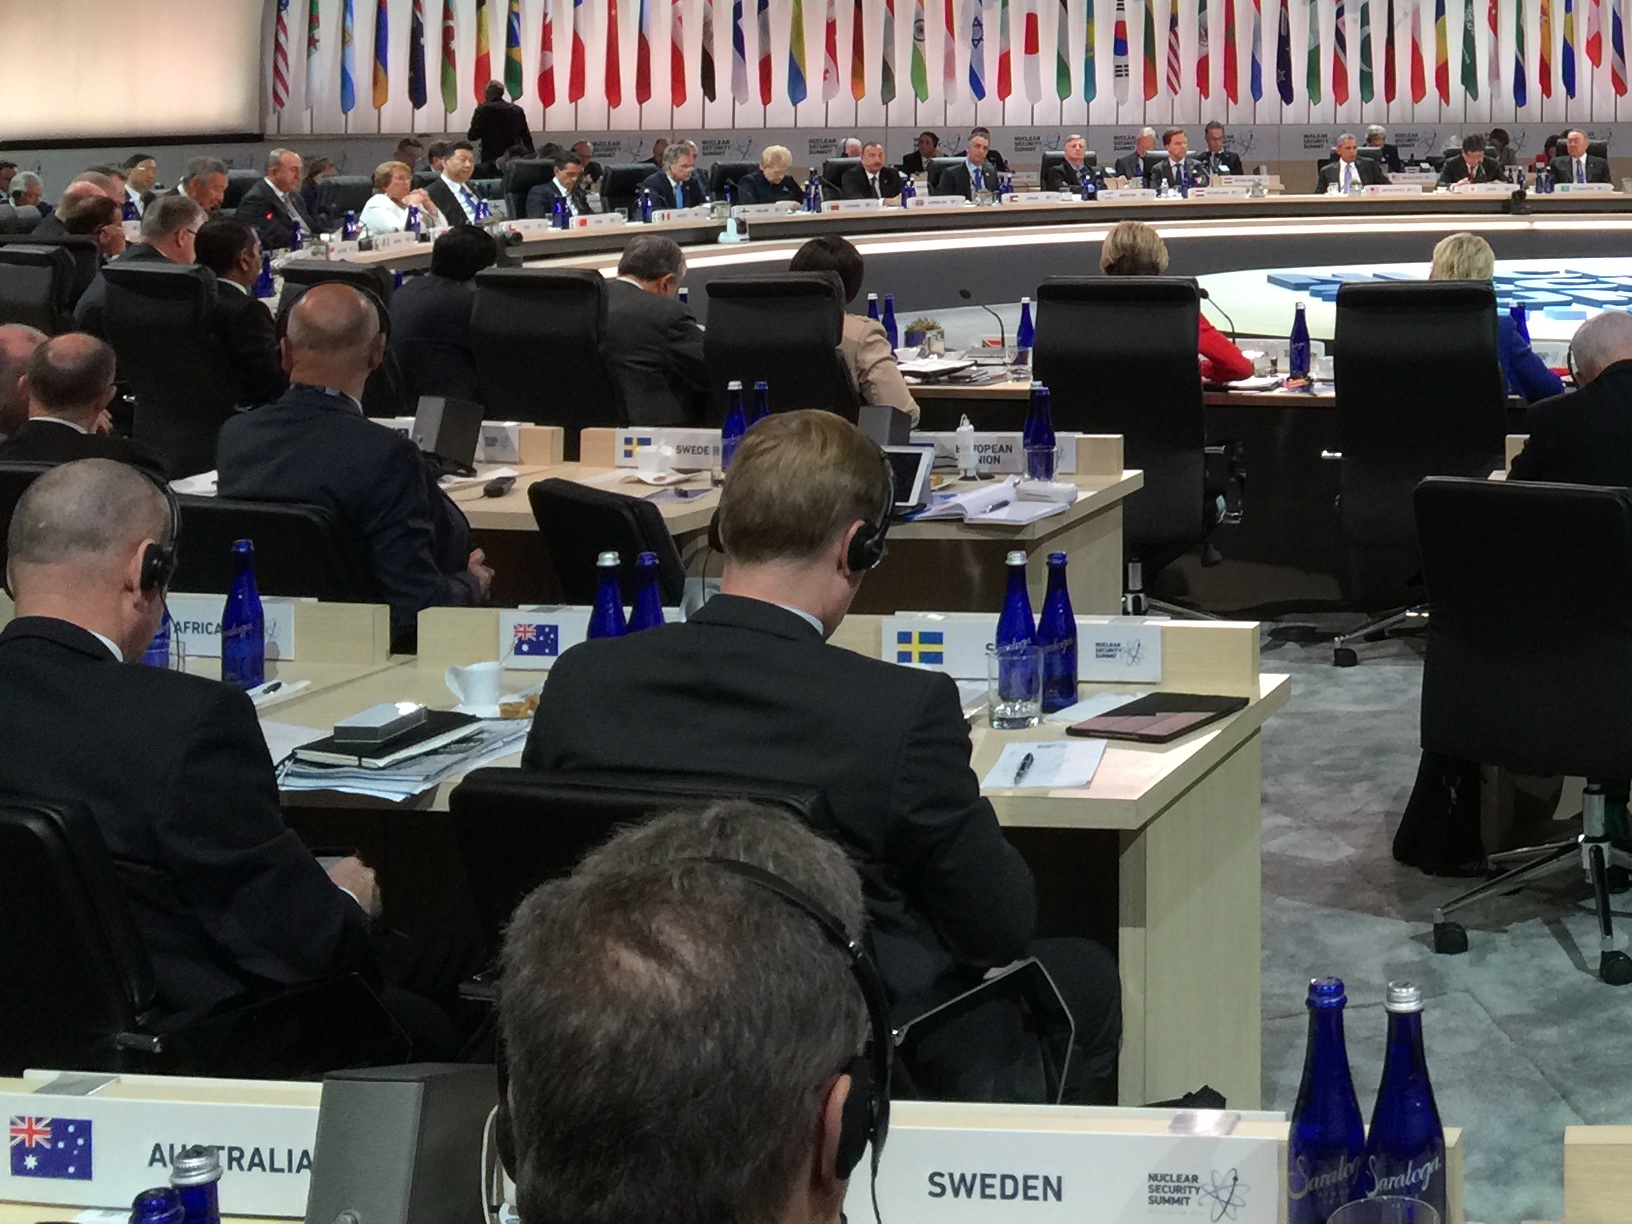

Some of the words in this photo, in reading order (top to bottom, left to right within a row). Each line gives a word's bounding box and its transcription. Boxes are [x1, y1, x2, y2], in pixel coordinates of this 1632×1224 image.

[978, 454, 1001, 465] NION
[174, 620, 221, 635] AFRICA
[147, 1142, 313, 1174] AUTRALIA
[1147, 1173, 1199, 1184] NUCLEAR
[927, 1171, 1063, 1202] SWEDEN
[1147, 1184, 1201, 1195] SECURITY
[1147, 1195, 1192, 1206] SUMMIT
